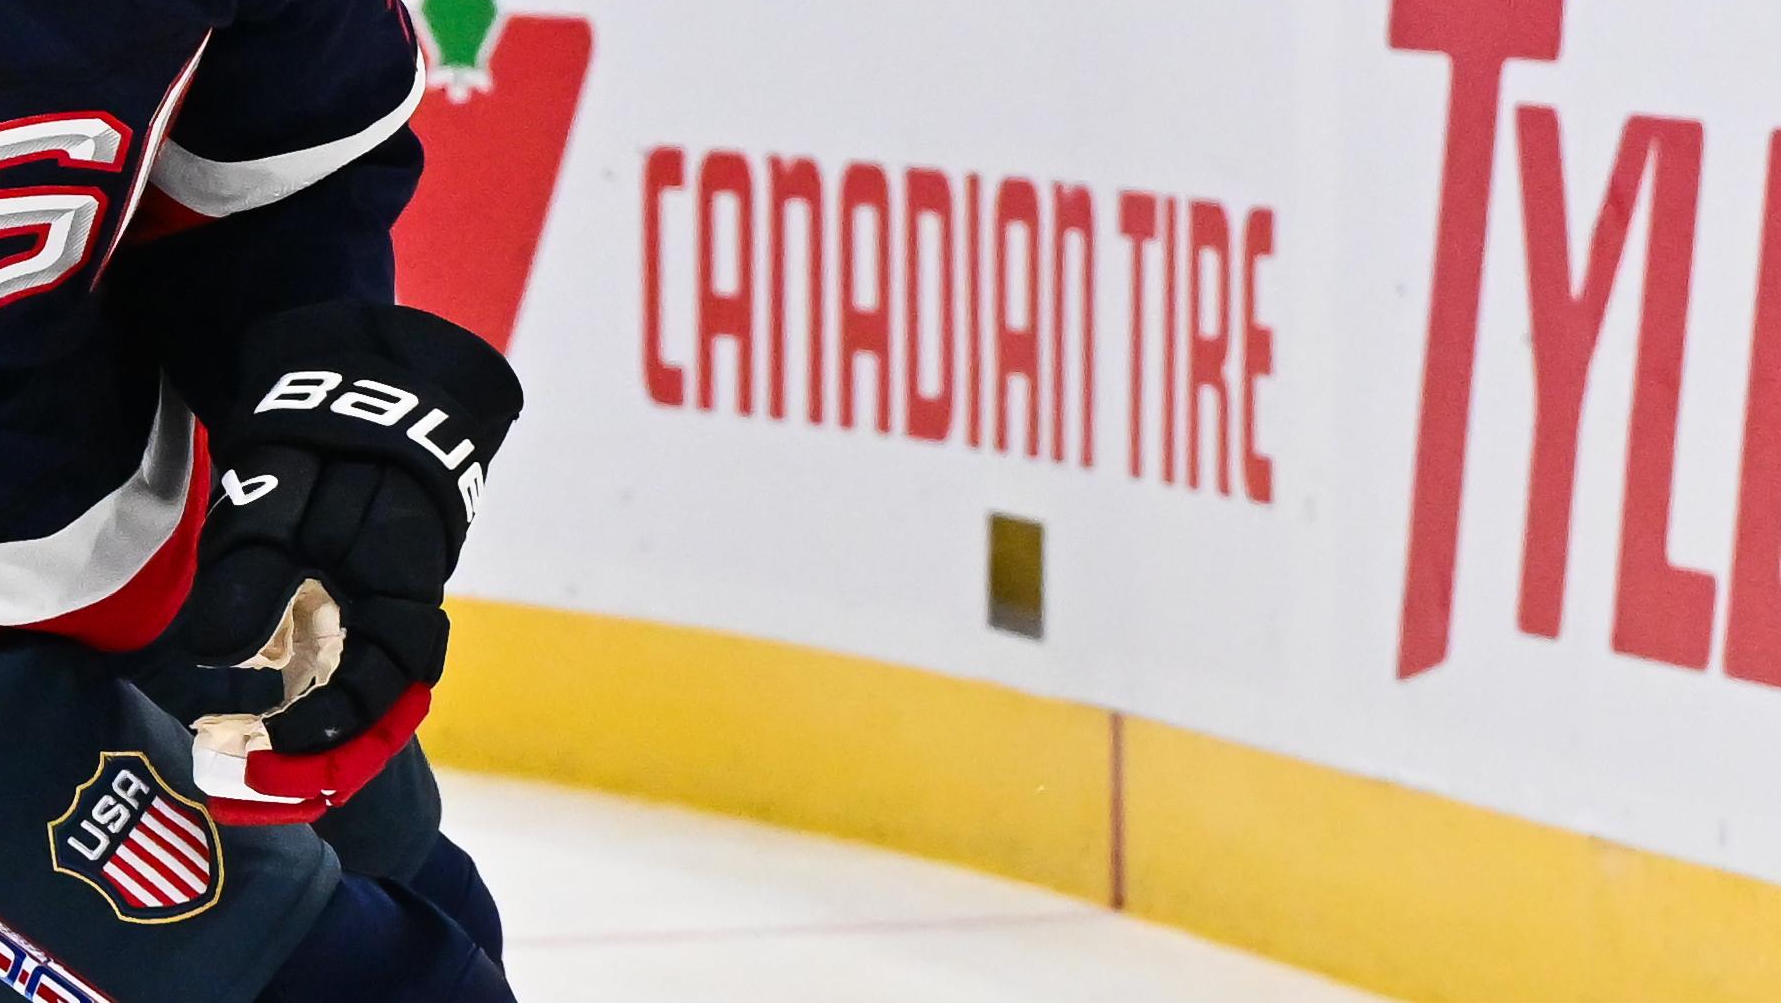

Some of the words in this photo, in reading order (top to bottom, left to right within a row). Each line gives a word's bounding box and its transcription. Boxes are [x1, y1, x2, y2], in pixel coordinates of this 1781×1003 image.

[641, 144, 1095, 468] CANADIAN
[1117, 189, 1274, 505] TIRE
[253, 370, 486, 523] BAUE
[67, 769, 150, 861] USA
